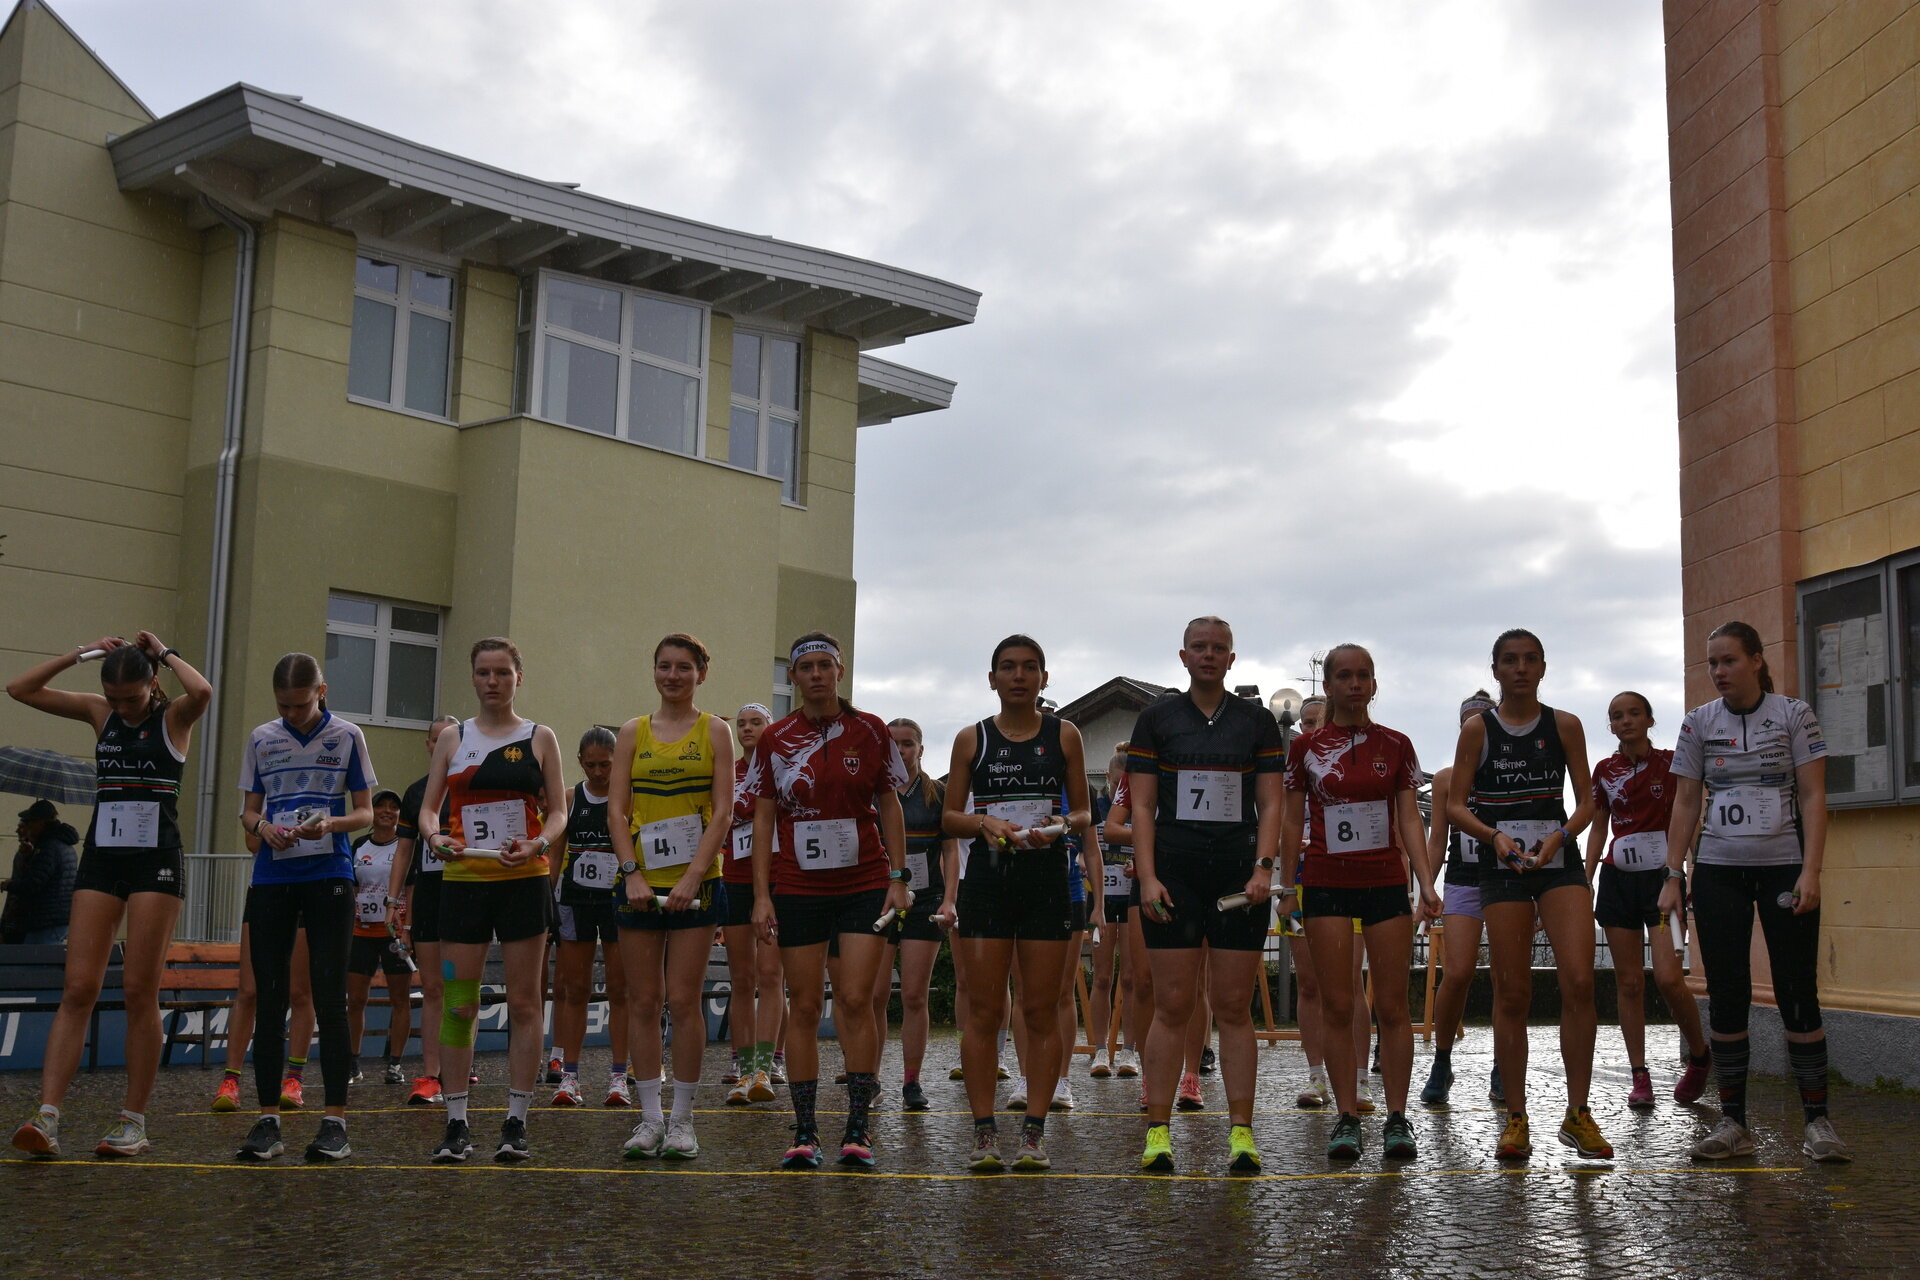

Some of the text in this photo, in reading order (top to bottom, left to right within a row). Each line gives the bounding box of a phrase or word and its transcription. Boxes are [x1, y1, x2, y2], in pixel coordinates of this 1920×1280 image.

[98, 759, 157, 771] ITALIA
[988, 762, 1023, 774] TRENTINO
[1492, 758, 1527, 770] TRENTINO
[988, 776, 1058, 787] ITALIA
[1496, 770, 1560, 785] ITALIA
[1190, 788, 1205, 810] 7
[1719, 804, 1745, 826] 10
[111, 818, 118, 837] 1
[473, 820, 489, 841] 3
[1337, 821, 1354, 842] 8
[654, 838, 670, 857] 4
[805, 838, 821, 859] 5
[1622, 847, 1638, 865] 11
[580, 863, 598, 880] 18
[362, 902, 378, 914] 29
